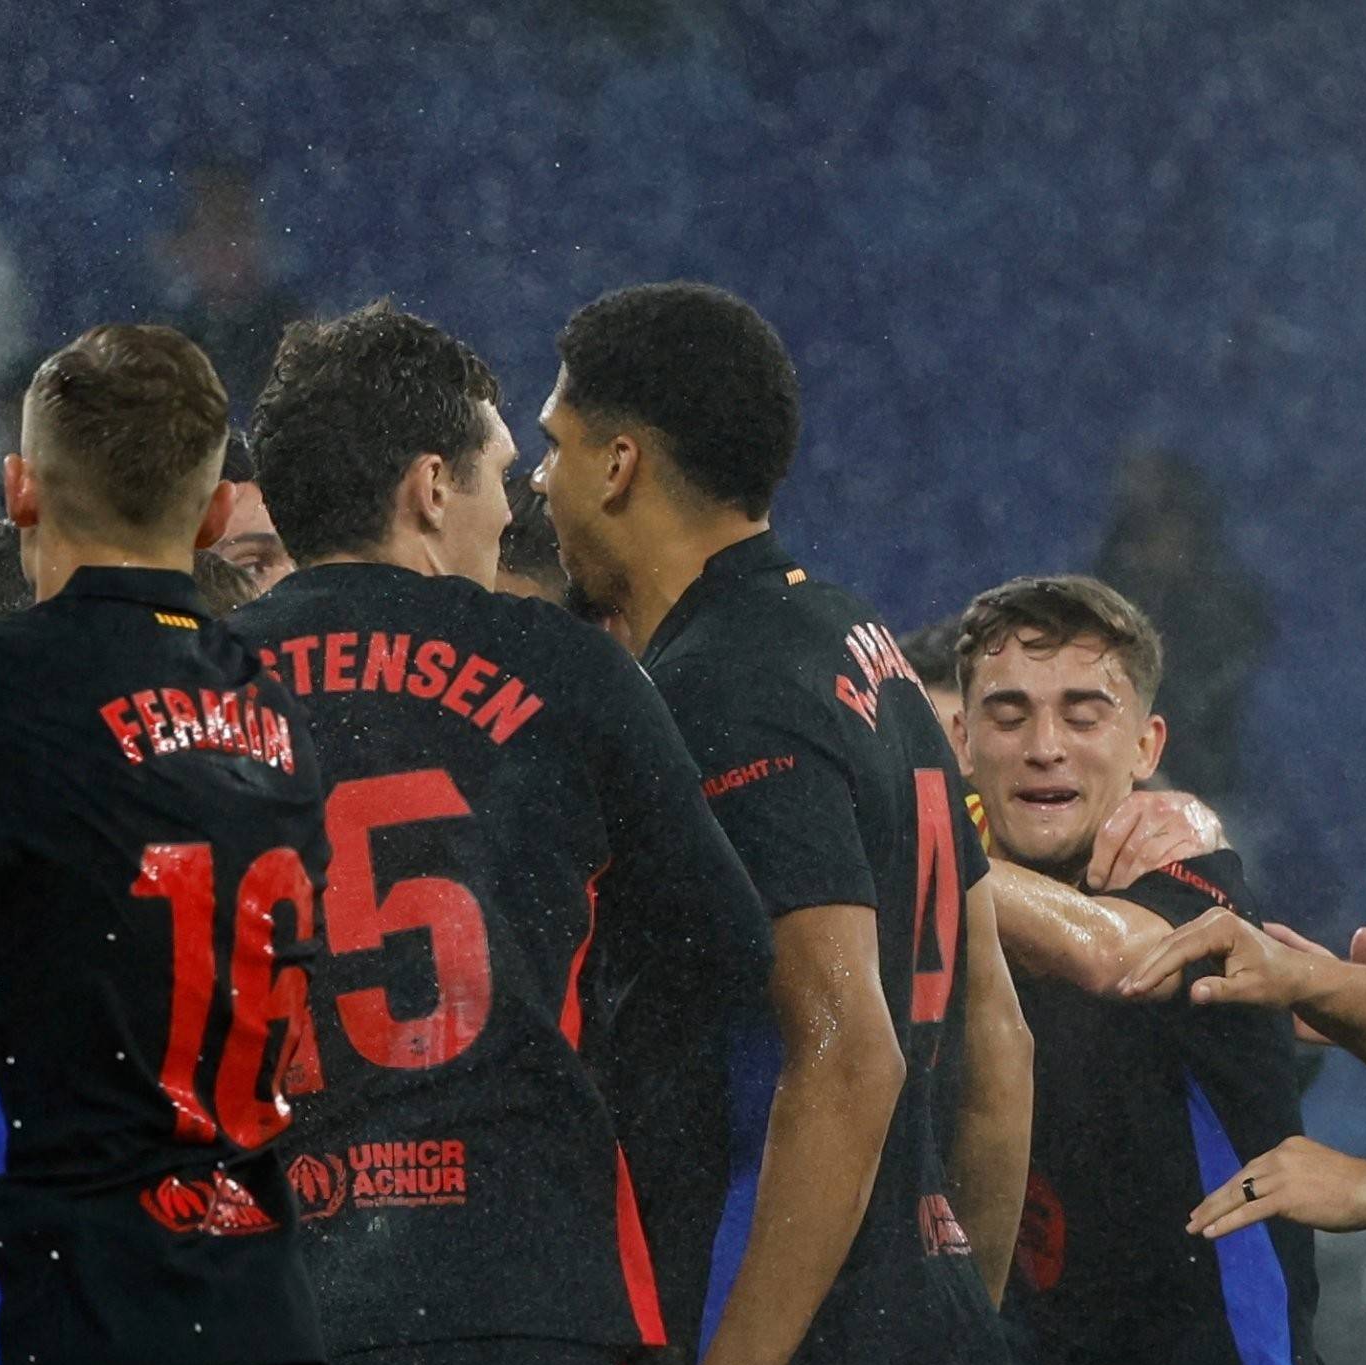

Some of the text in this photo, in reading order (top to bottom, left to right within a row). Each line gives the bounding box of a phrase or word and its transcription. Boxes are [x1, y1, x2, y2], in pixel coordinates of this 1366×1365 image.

[129, 842, 315, 1150] 16
[286, 768, 492, 1095] 5
[911, 768, 960, 1022] 4
[348, 1139, 467, 1171] UNHCR
[354, 1167, 468, 1197] ACNUR
